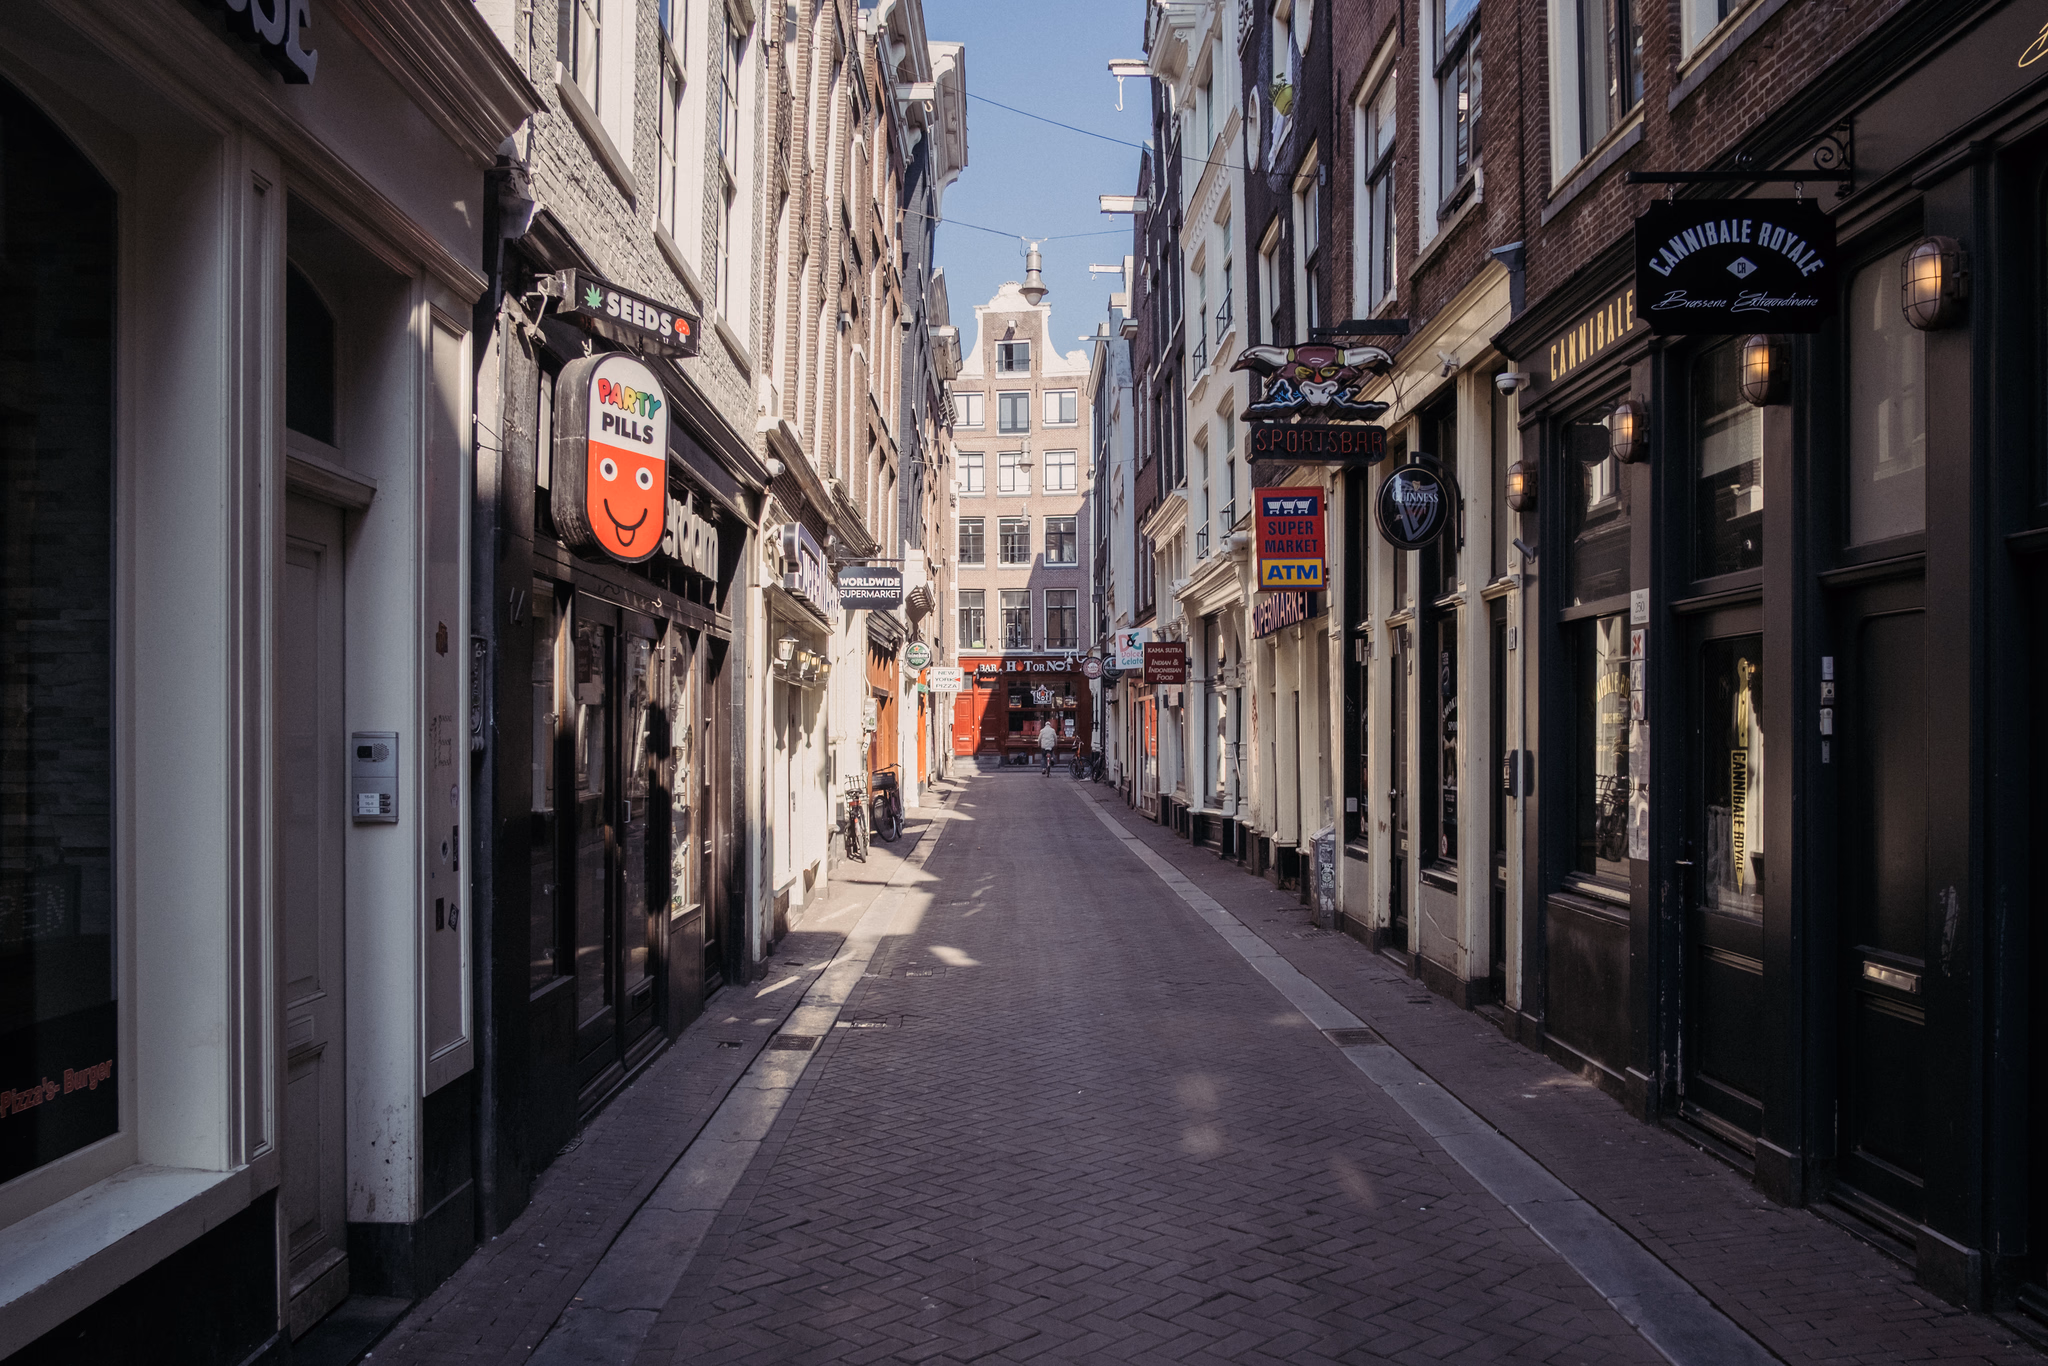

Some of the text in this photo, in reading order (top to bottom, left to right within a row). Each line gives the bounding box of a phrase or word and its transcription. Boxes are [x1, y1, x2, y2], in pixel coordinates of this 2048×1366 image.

[1648, 218, 1824, 277] CANNIBALE ROYALE
[1737, 262, 1746, 274] CR
[1651, 289, 1819, 313] Brasserie Extraordinaire
[606, 291, 672, 337] SEEDS
[1550, 288, 1634, 382] CANNIBALE
[597, 377, 662, 420] PARTY
[601, 411, 654, 445] PILLS
[1256, 428, 1383, 453] SPORTSBAR
[1391, 488, 1439, 503] GUINNESS
[1267, 520, 1314, 535] SUPER
[1264, 539, 1318, 553] MARKET
[839, 577, 900, 587] WORLDWIDE
[1267, 565, 1318, 580] ATM
[839, 590, 901, 599] SUPERMARKET
[1635, 601, 1645, 613] 250
[979, 664, 997, 672] BAR
[1732, 751, 1746, 873] CANNIBALE ROYALE
[63, 1059, 113, 1095] Burger
